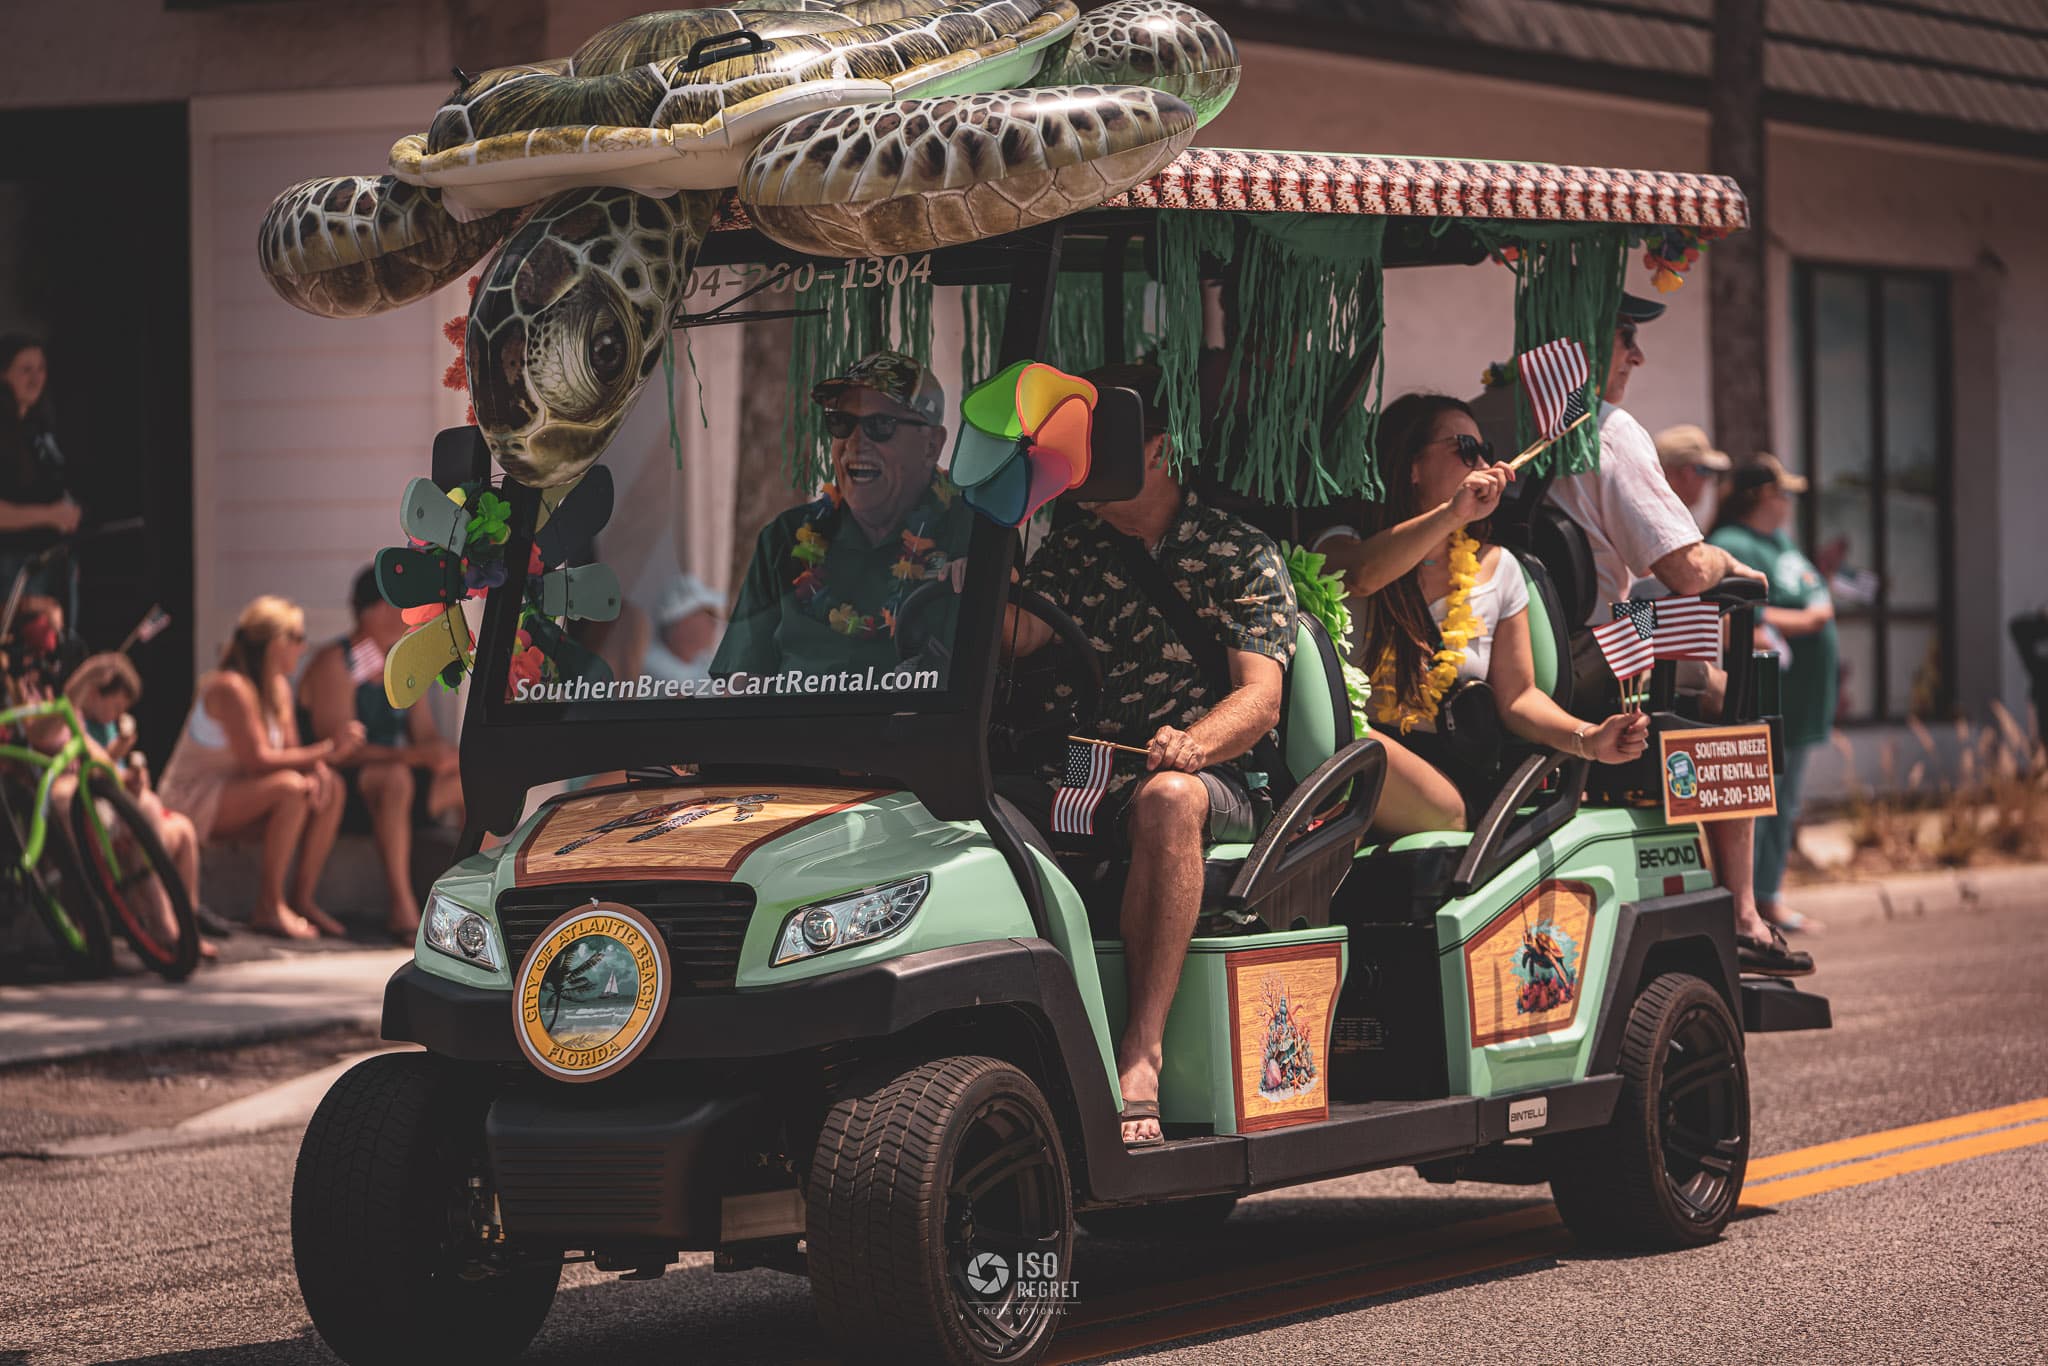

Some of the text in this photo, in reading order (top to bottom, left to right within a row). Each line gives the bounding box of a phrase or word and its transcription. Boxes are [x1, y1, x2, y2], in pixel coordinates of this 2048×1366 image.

[514, 666, 939, 701] SouthernBreezeCartRental.com
[1695, 738, 1767, 759] SOUTHERN BREEZE
[1697, 763, 1768, 783] CART RENTAL LLC
[1699, 785, 1771, 808] 904-200-1304
[1639, 845, 1696, 869] BEYOND
[525, 918, 656, 1023] CITY OF ATLANTIC BEACH
[547, 1040, 622, 1066] FLORIDA
[1511, 1107, 1545, 1122] BINTELLI
